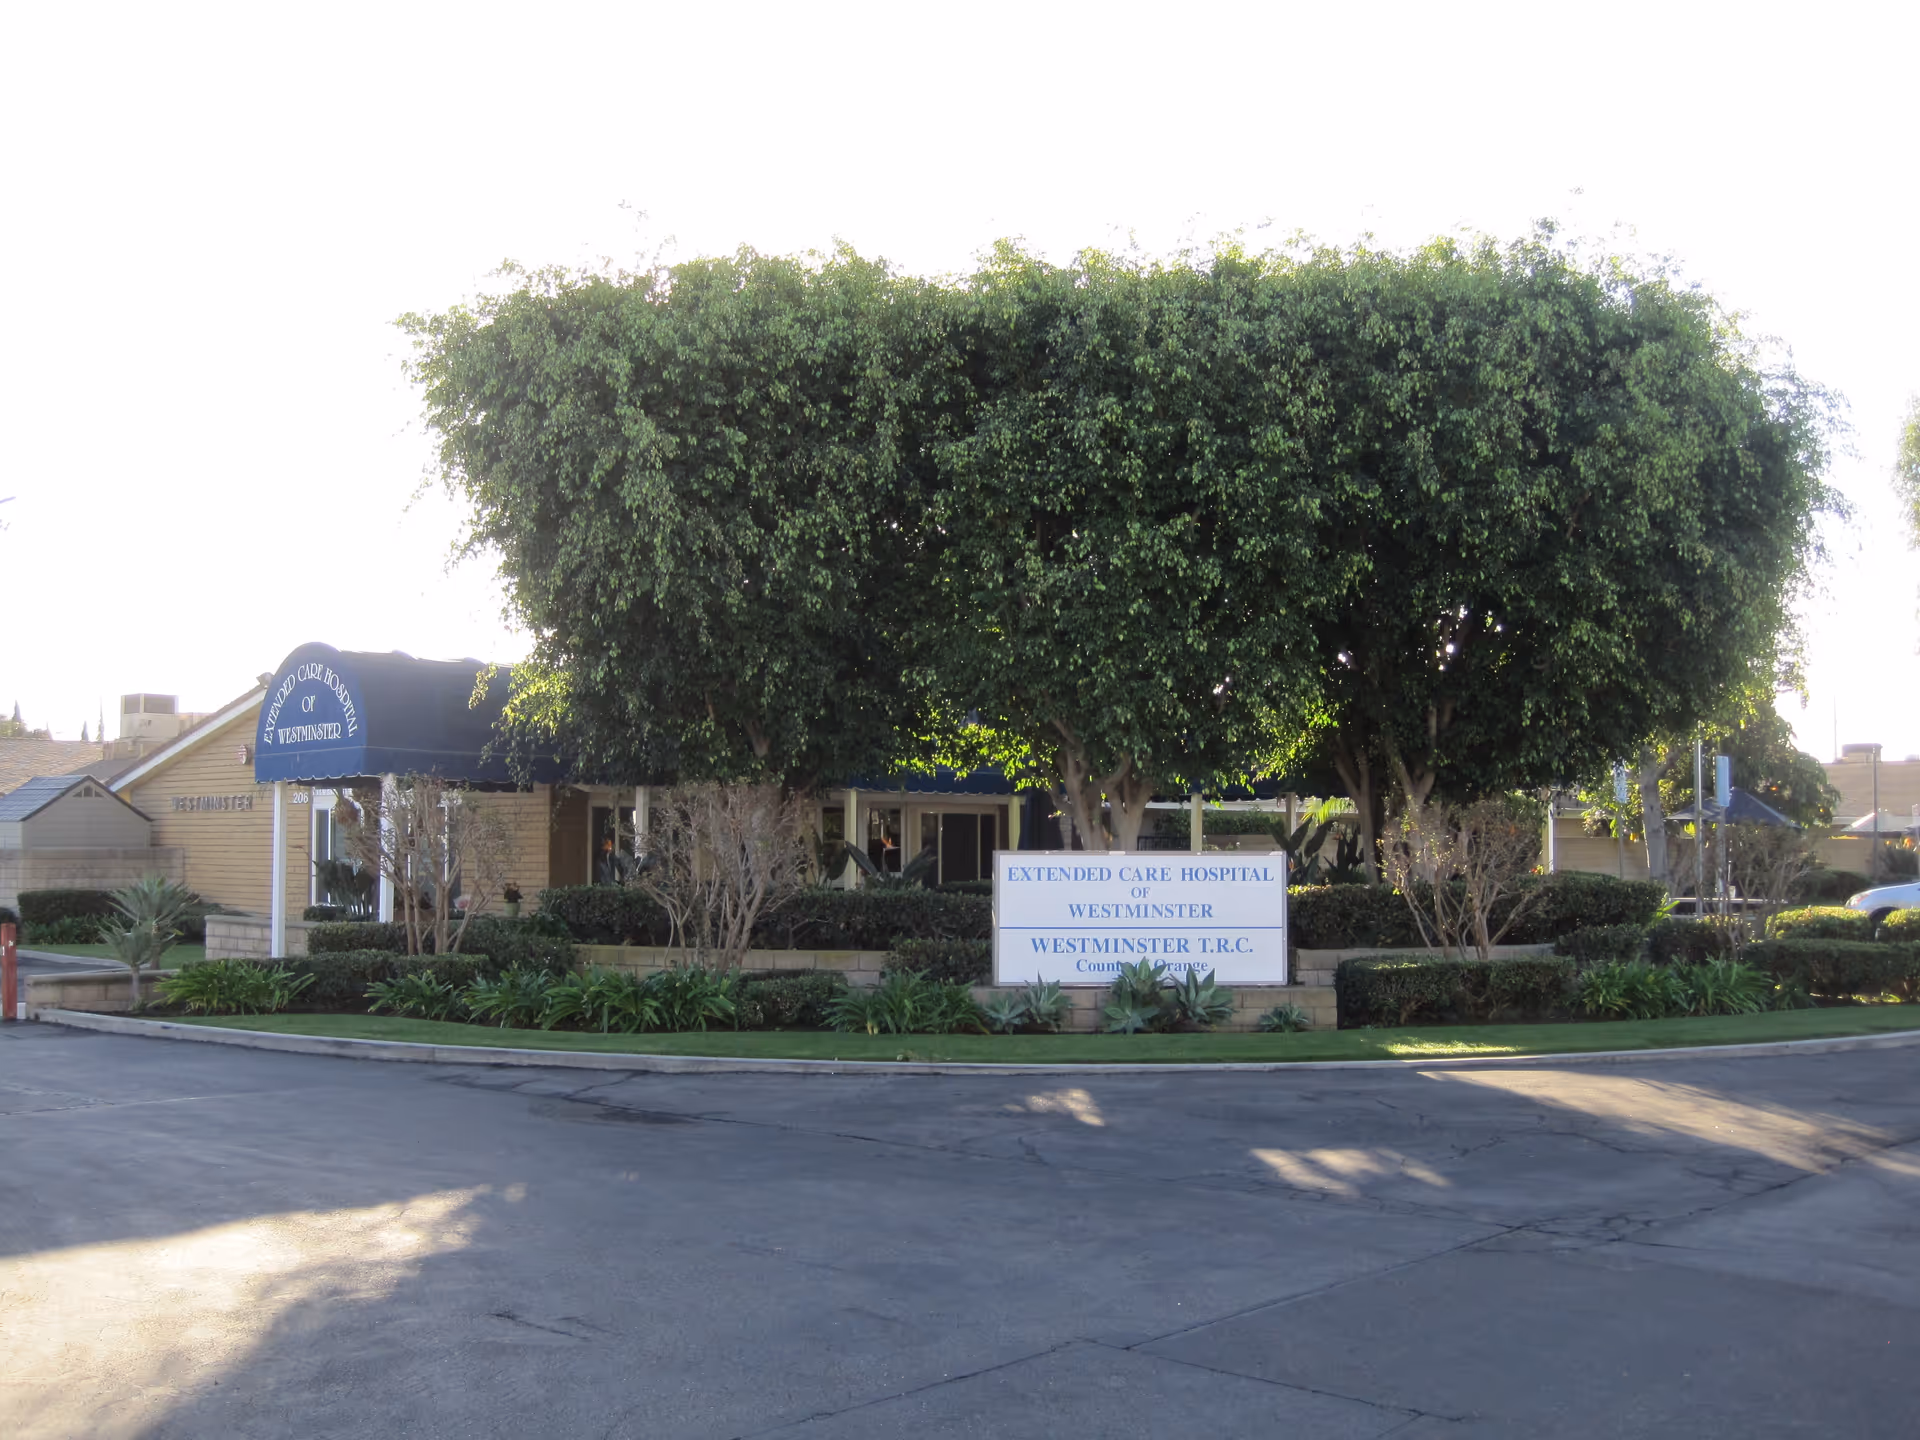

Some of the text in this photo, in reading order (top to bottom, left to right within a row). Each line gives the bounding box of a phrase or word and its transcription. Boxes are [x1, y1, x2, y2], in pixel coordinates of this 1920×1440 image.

[264, 663, 358, 744] EXTENDED CARE HOSPITAL
[301, 695, 316, 713] OF
[277, 722, 342, 745] WESTMINSTER
[293, 791, 309, 804] 206
[1007, 867, 1275, 882] EXTENDED CARE HOSPITAL
[1130, 886, 1151, 899] OF
[1068, 903, 1214, 919] WESTMINSTER
[1031, 937, 1253, 954] WESTMINSTER T.R.C.
[1076, 959, 1127, 974] Count
